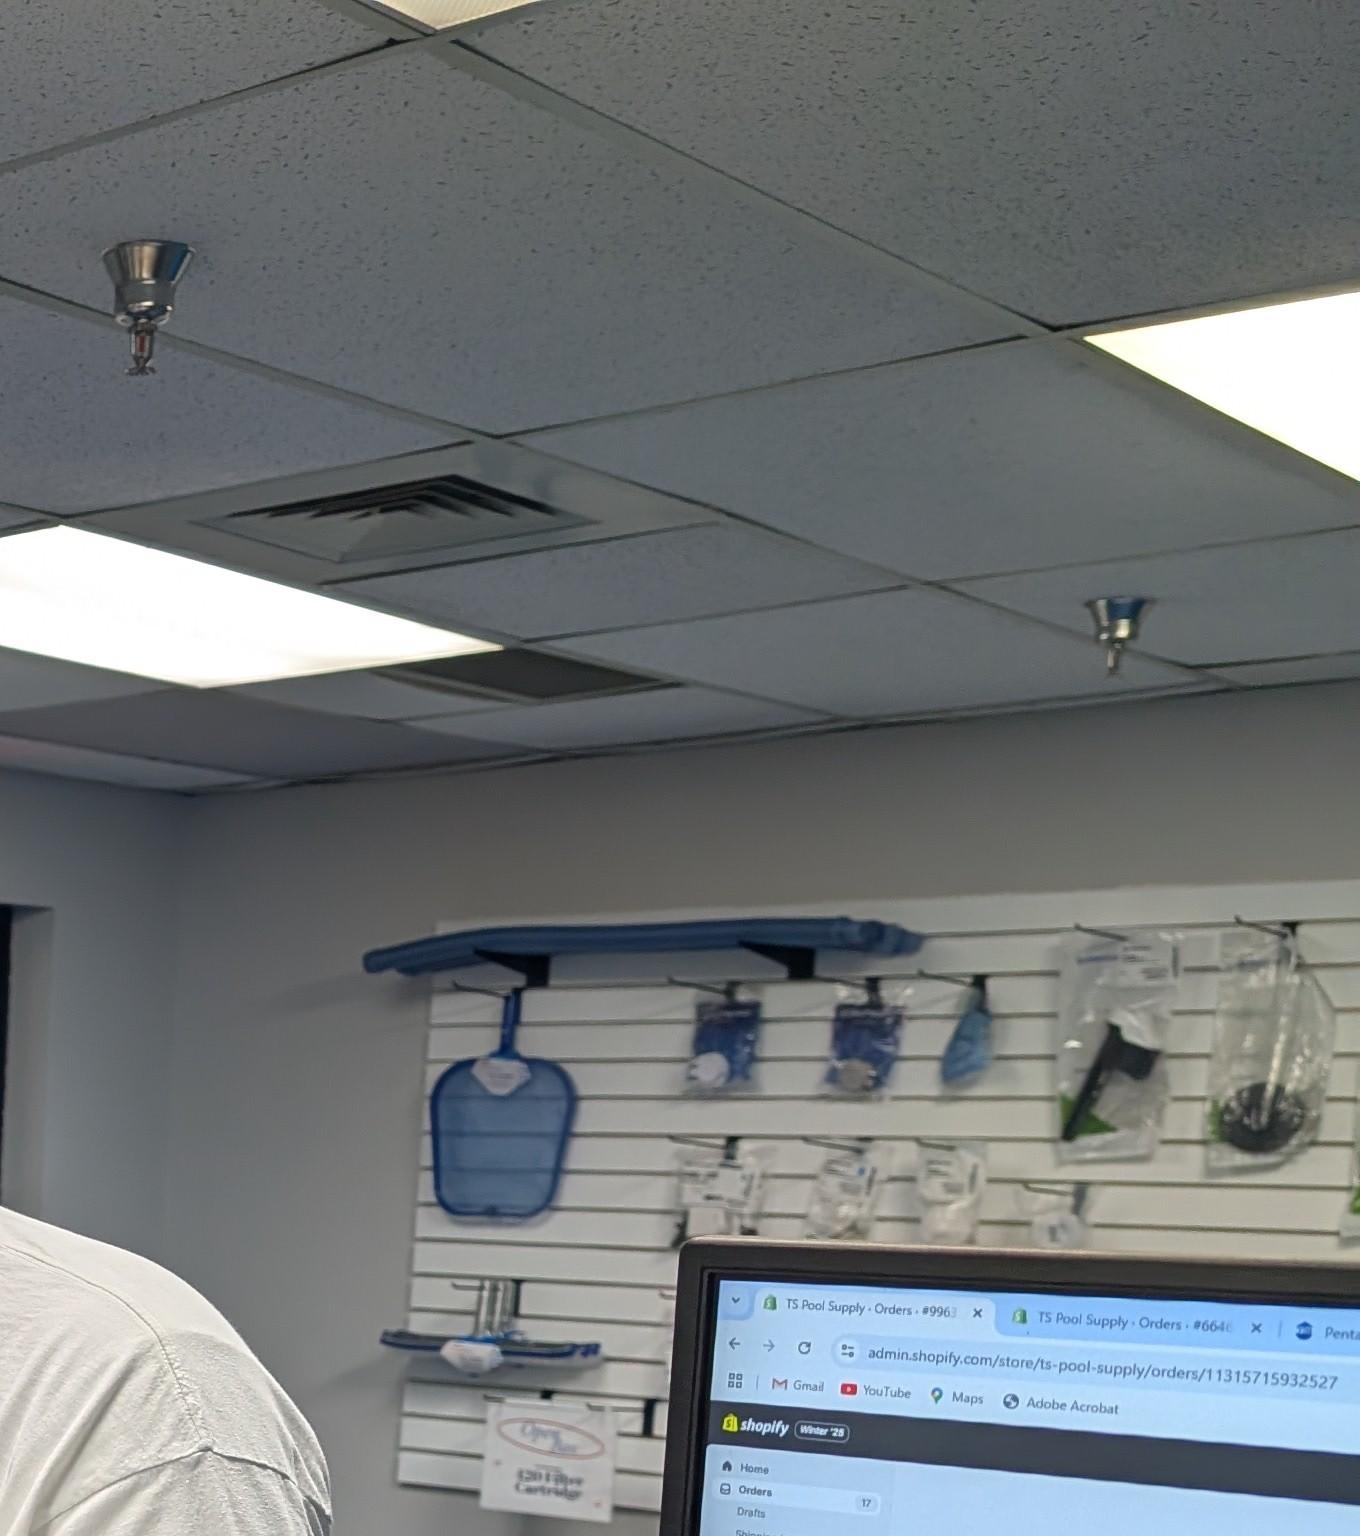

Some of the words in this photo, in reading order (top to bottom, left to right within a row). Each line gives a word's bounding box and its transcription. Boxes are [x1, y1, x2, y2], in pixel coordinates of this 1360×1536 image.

[787, 1299, 798, 1310] TS
[801, 1300, 825, 1312] Pool
[829, 1301, 865, 1316] Supply
[875, 1304, 912, 1316] Orders
[1038, 1311, 1052, 1323] TS
[1056, 1313, 1082, 1325] Pool
[1086, 1314, 1128, 1330] Supply
[1139, 1317, 1181, 1331] Orders
[793, 1380, 824, 1392] Gmail
[863, 1385, 911, 1399] YouTube
[952, 1391, 984, 1408] Maps
[1027, 1397, 1067, 1411] Adobe
[1070, 1400, 1119, 1415] Acrobat
[740, 1418, 789, 1437] shopify
[800, 1425, 828, 1436] Winter
[740, 1463, 769, 1474] Home
[739, 1485, 772, 1497] Orders
[737, 1507, 766, 1518] Drafts
